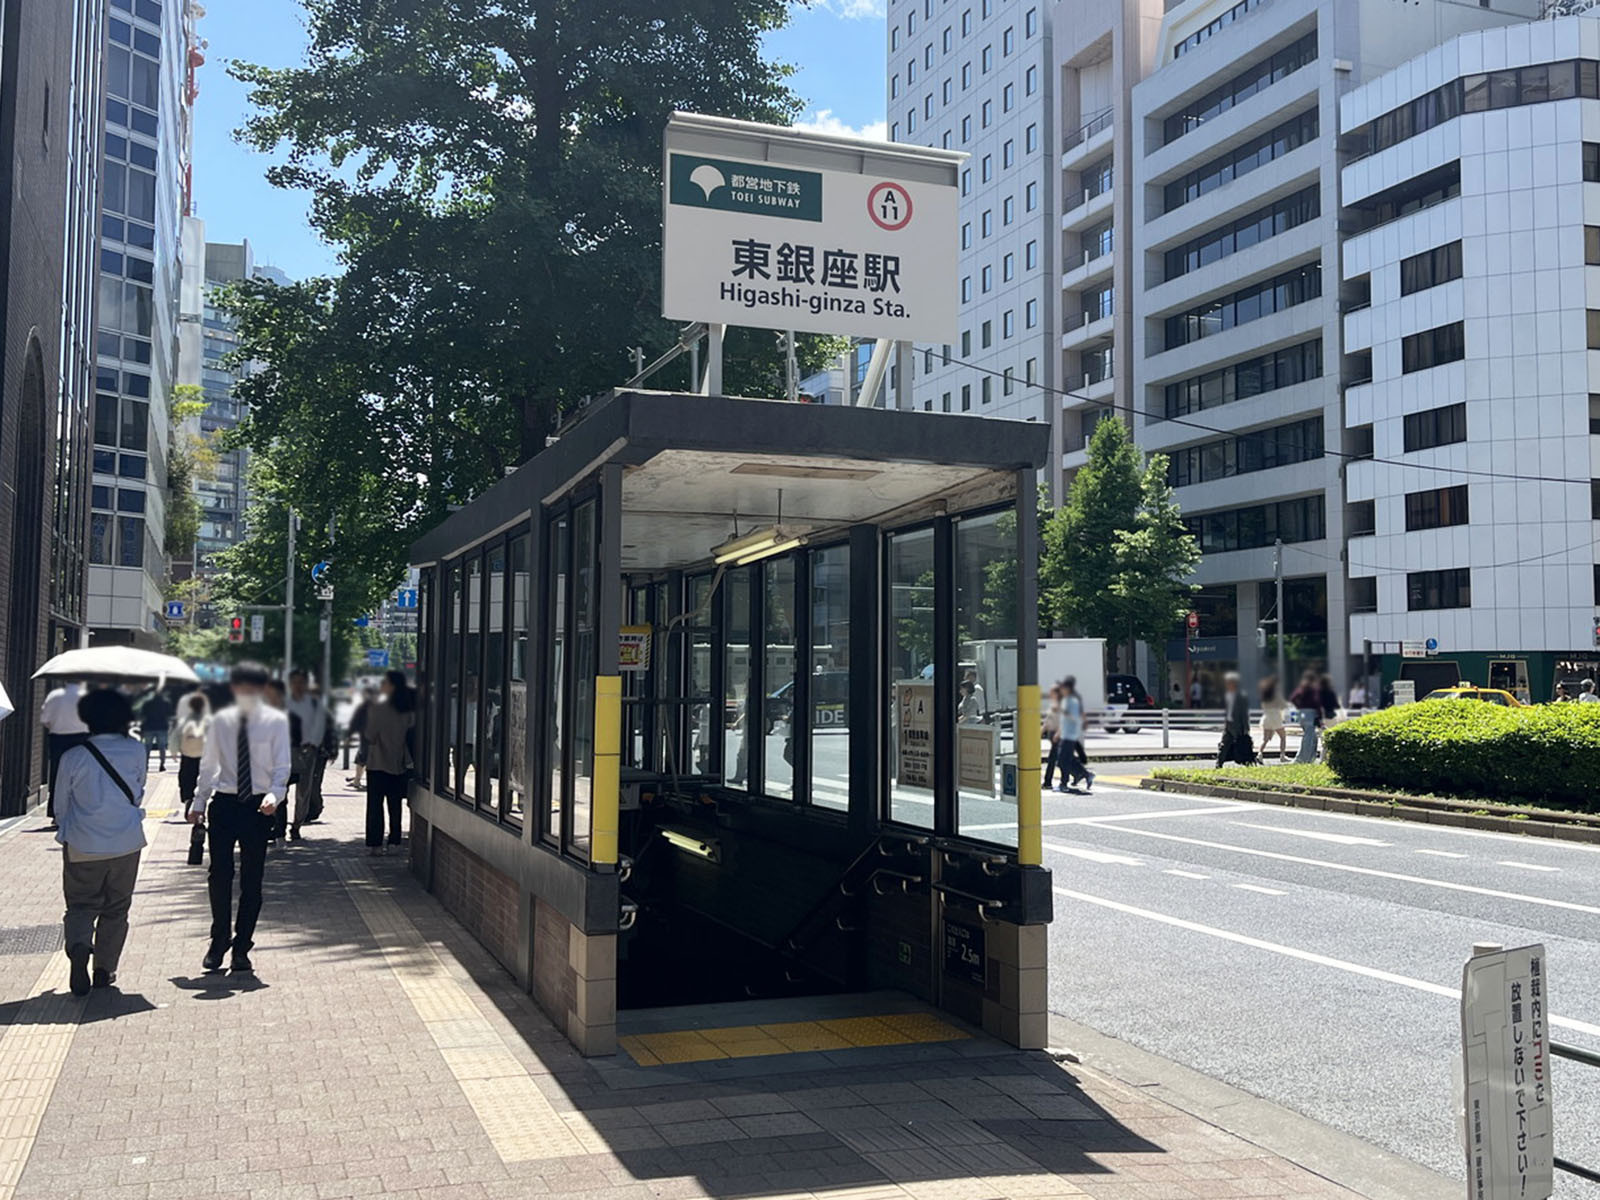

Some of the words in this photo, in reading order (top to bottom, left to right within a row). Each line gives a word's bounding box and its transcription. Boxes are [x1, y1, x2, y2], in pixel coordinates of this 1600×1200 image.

[731, 174, 801, 196] 都営地下鉄
[731, 191, 754, 203] TOEI
[758, 194, 801, 208] SUBWAY
[884, 190, 896, 204] A
[881, 205, 898, 220] 11
[731, 238, 901, 294] 東銀座駅
[720, 281, 866, 314] Higashi-ginza
[873, 298, 911, 318] Sta.
